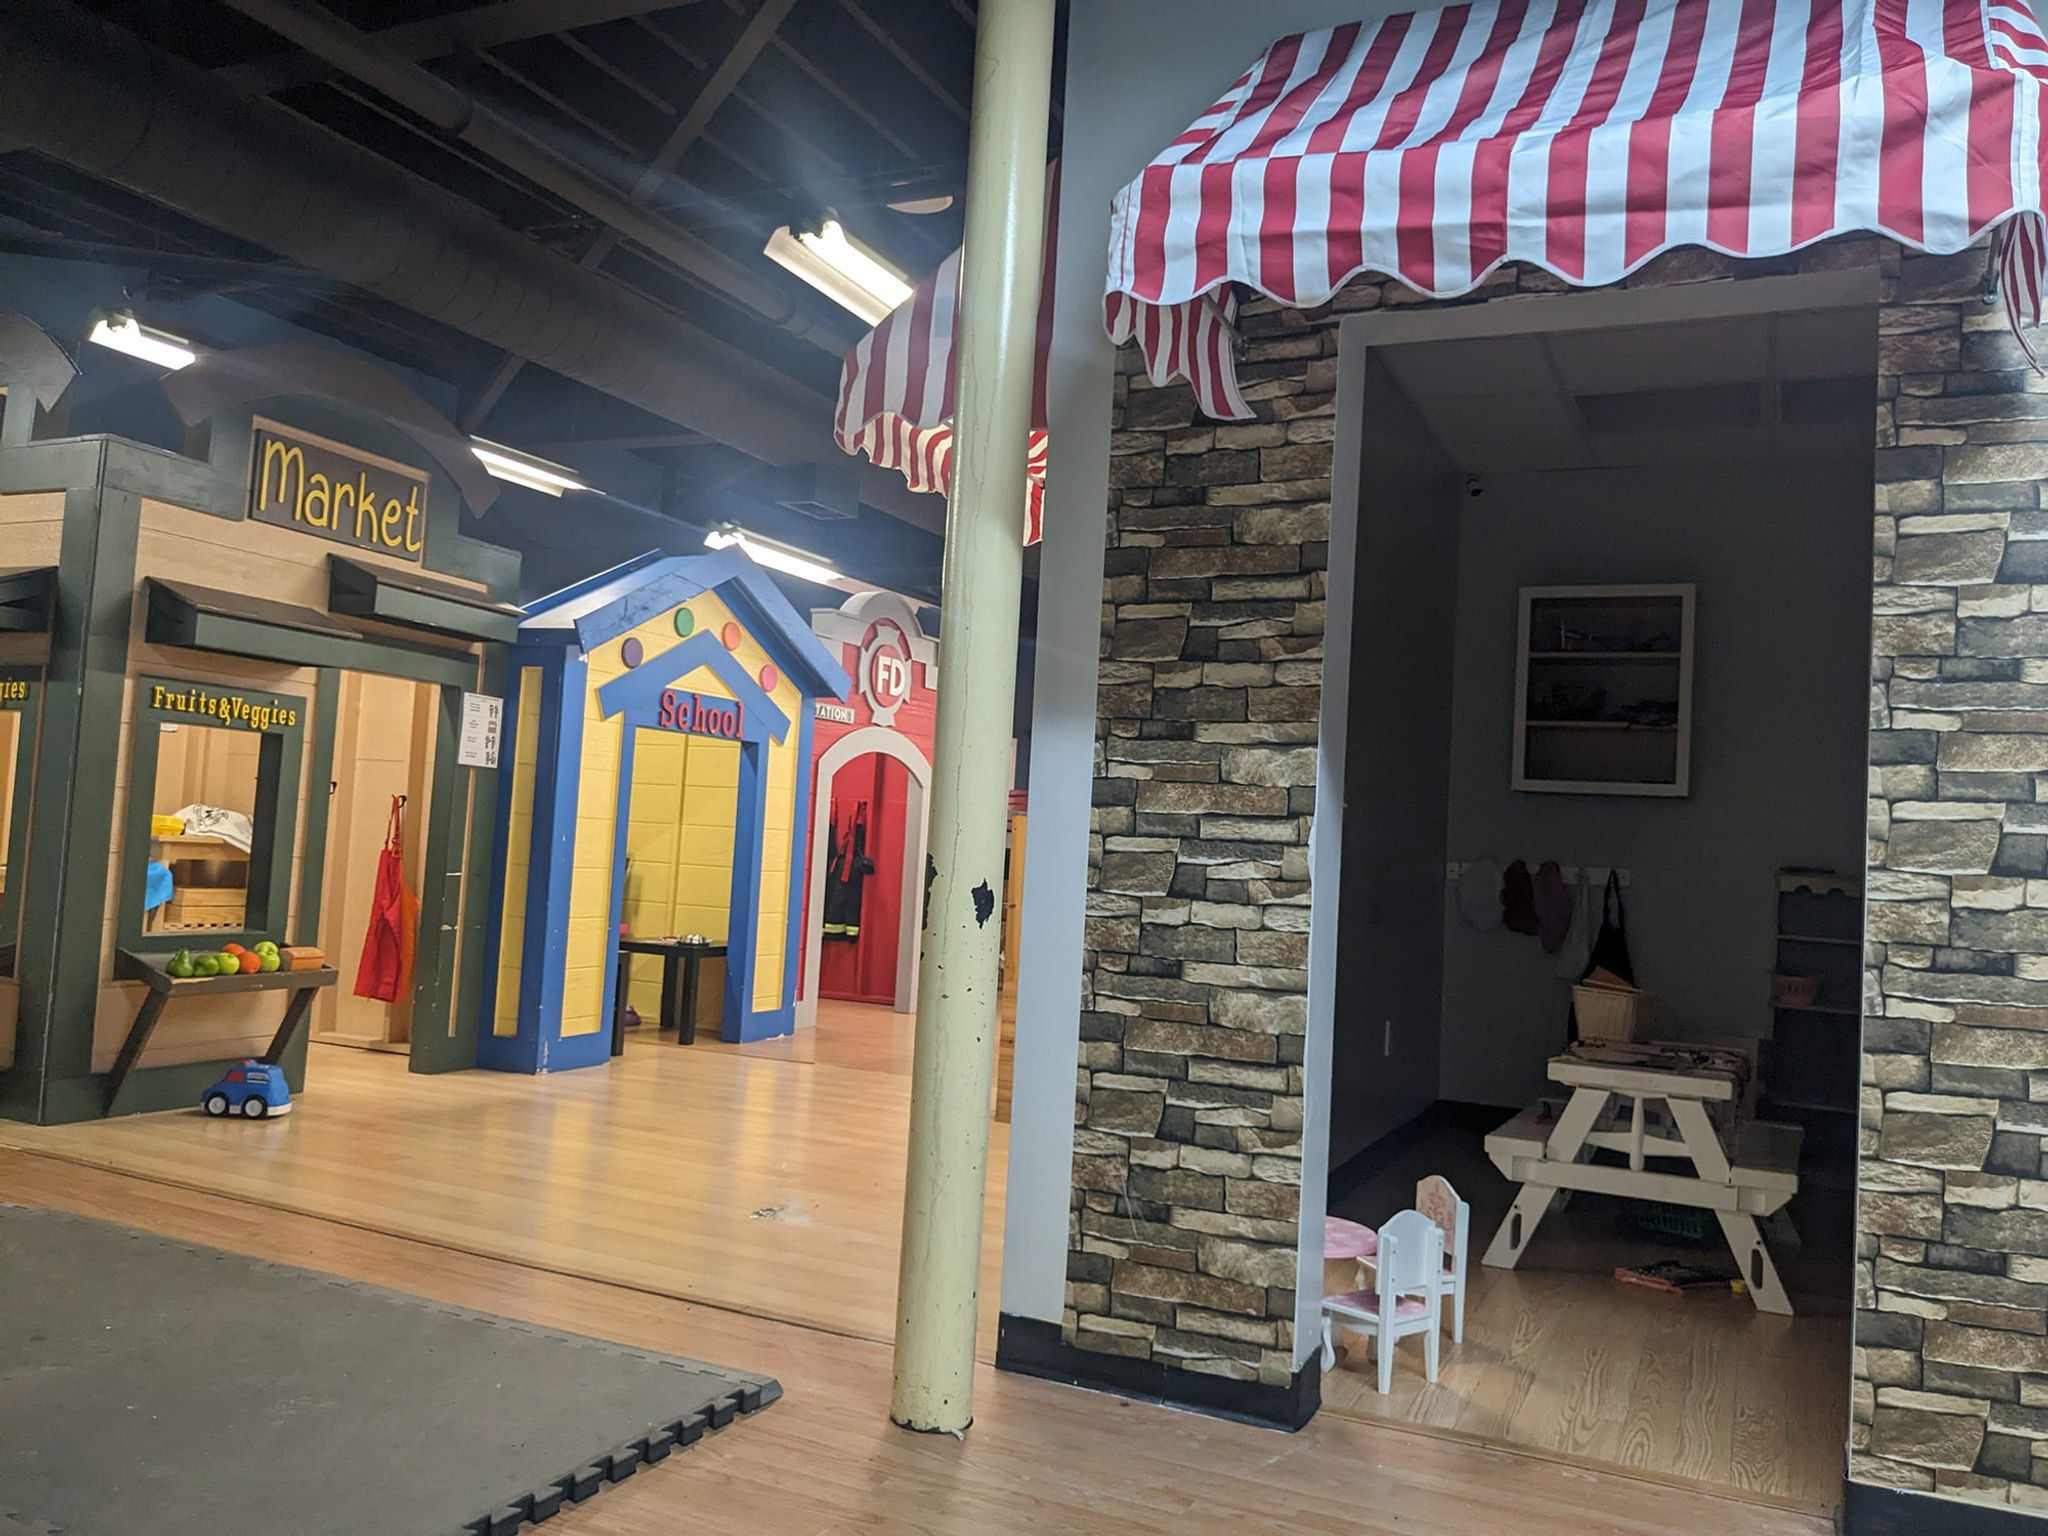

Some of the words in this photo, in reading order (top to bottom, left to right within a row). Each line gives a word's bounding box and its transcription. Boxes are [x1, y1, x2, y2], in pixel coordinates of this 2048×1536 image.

[259, 438, 422, 552] Market
[876, 655, 906, 697] FD
[153, 684, 297, 731] Fruits&Veggies
[659, 689, 745, 739] School
